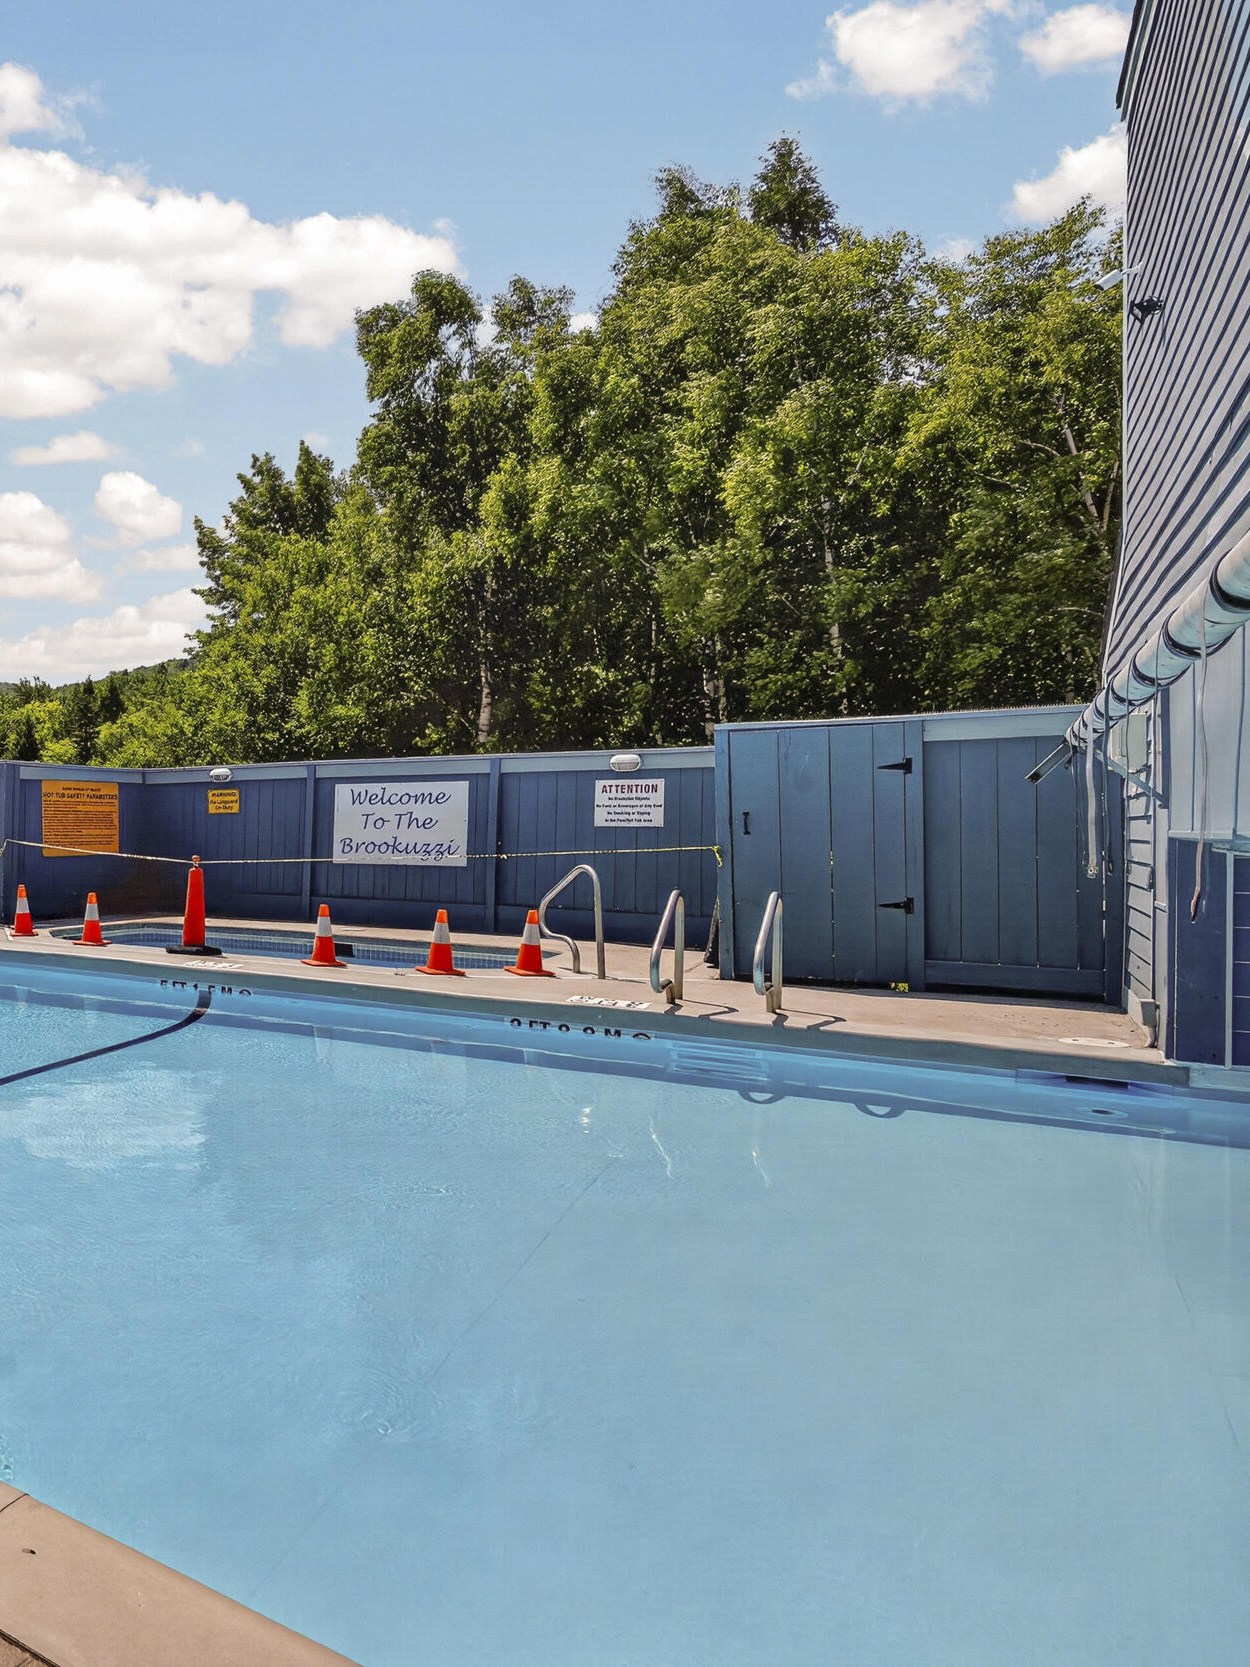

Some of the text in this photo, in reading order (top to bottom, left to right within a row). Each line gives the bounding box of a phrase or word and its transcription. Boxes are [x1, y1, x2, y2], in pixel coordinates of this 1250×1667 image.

[350, 786, 452, 806] Welcome
[601, 784, 658, 794] ATTENTION
[361, 811, 439, 830] To The
[340, 835, 461, 861] Brookuzzi
